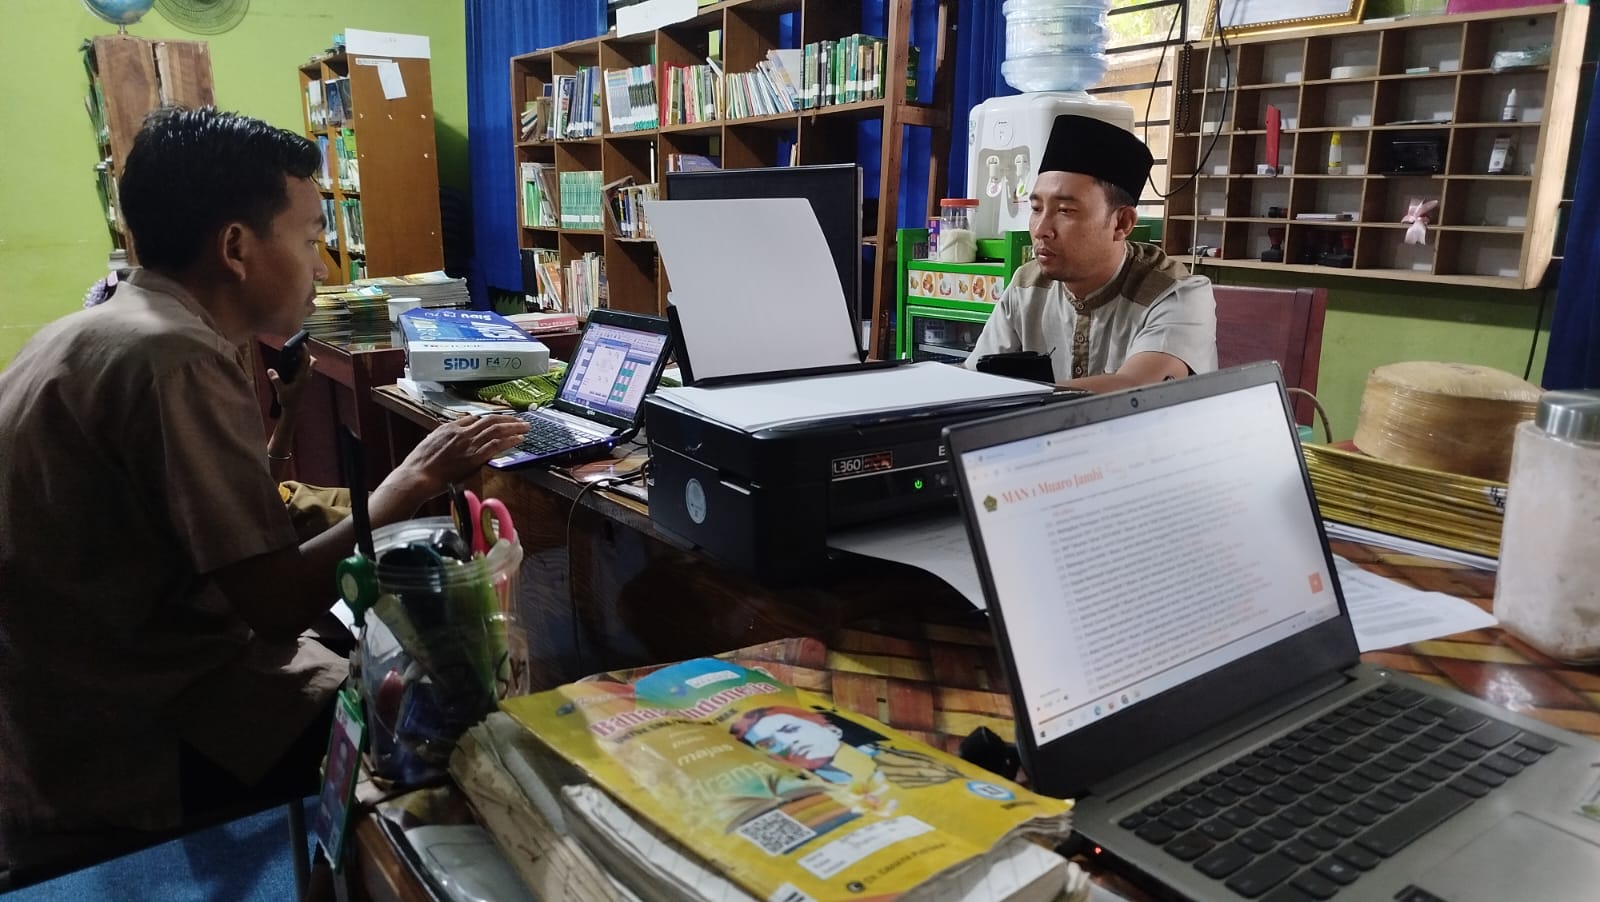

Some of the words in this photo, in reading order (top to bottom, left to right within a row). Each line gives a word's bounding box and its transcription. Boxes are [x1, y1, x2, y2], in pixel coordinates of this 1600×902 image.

[443, 357, 480, 370] SiDU
[486, 357, 500, 367] F4
[503, 357, 522, 370] 70
[833, 458, 862, 474] L360
[1001, 488, 1030, 504] MAN
[1037, 480, 1073, 494] Muaro
[1072, 469, 1104, 488] Jambi
[678, 743, 734, 766] majas
